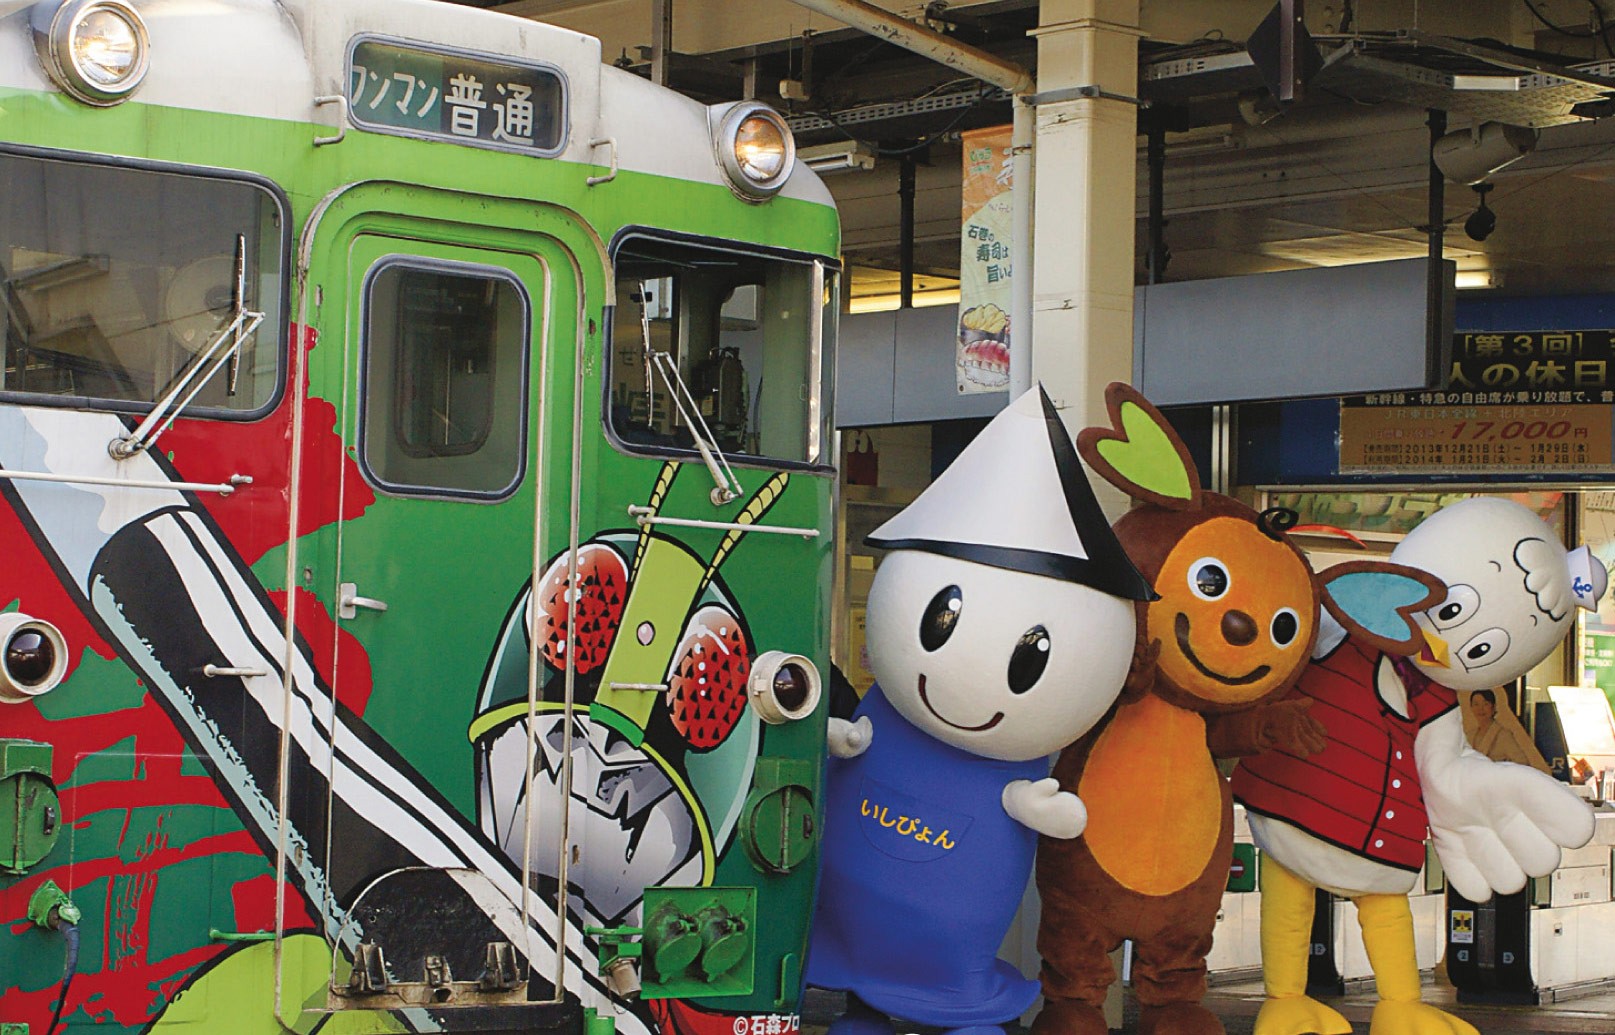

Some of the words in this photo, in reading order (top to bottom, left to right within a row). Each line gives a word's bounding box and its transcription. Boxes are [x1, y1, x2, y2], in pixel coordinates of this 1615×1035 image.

[445, 73, 534, 145] 普通
[861, 799, 955, 849] いしぴょん
